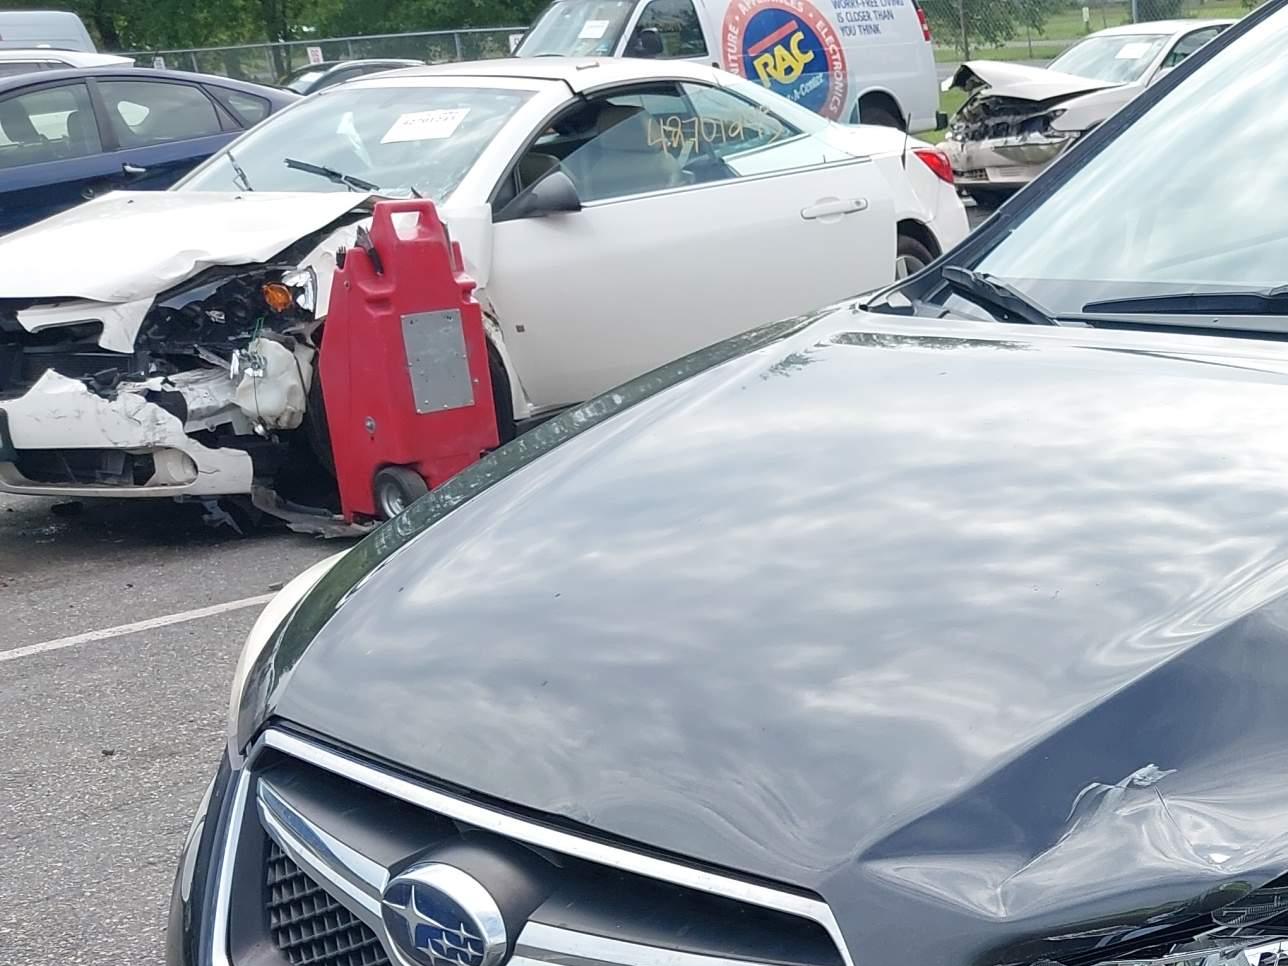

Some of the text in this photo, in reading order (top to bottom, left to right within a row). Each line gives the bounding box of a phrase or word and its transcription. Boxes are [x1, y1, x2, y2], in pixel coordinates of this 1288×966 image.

[837, 9, 895, 23] IS CLOSER THAN
[840, 23, 882, 36] YOU THINK
[753, 31, 815, 88] RAC
[815, 20, 843, 113] ELECTRONICS
